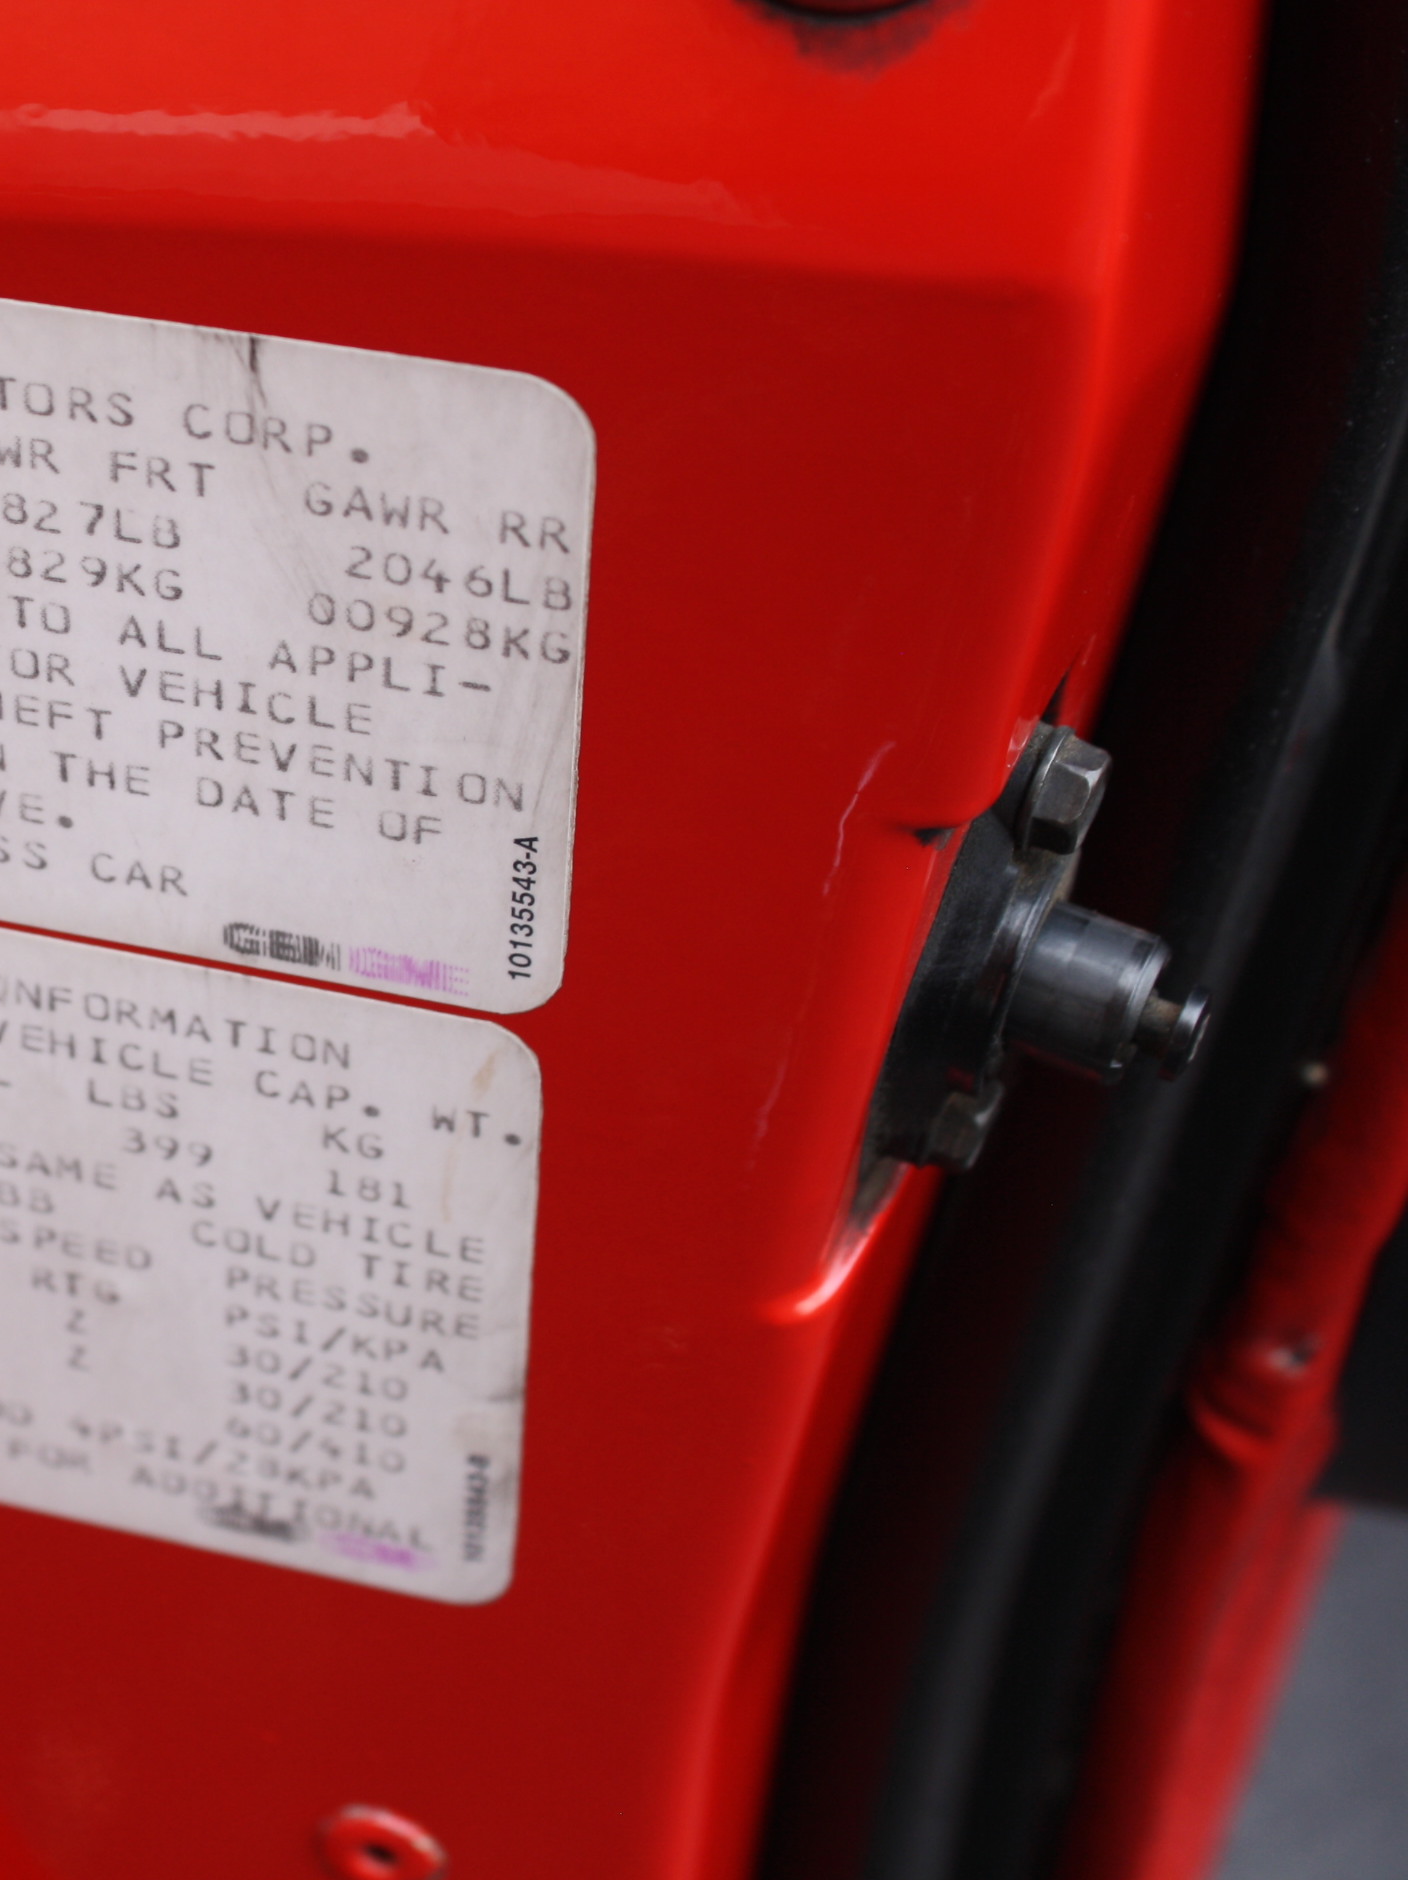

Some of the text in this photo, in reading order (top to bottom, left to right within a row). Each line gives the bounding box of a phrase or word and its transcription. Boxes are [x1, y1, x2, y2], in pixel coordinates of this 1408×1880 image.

[183, 403, 370, 465] CORP.
[110, 452, 217, 498] FRT
[304, 482, 450, 535] GAWR
[500, 511, 571, 554] RR
[345, 546, 574, 611] 2046LB
[12, 595, 72, 635] TO
[119, 616, 223, 661] ALL
[269, 639, 493, 698] APPLI-
[307, 592, 573, 665] 00928KG
[119, 665, 373, 736] VEHICLE
[54, 752, 152, 797] THE
[195, 779, 336, 830] DATE
[378, 810, 444, 845] OF
[159, 721, 525, 812] PREVENTION
[90, 852, 189, 897] CAR
[507, 835, 540, 982] 10135543-A
[86, 1078, 180, 1121] LBS
[321, 1126, 385, 1160] KG
[256, 1072, 381, 1119] CAP.
[430, 1105, 523, 1146] WT.
[121, 1128, 214, 1167] 399
[326, 1170, 413, 1209] 181
[155, 1176, 216, 1211] AS
[256, 1195, 484, 1264] VEHICLE
[192, 1221, 316, 1269] COLD
[358, 1253, 484, 1302] TIRE
[31, 1267, 445, 1373] RTG PSI/KPA
[225, 1266, 480, 1340] PRESSURE
[226, 1345, 409, 1403] 30/210
[226, 1383, 408, 1439] 30/210
